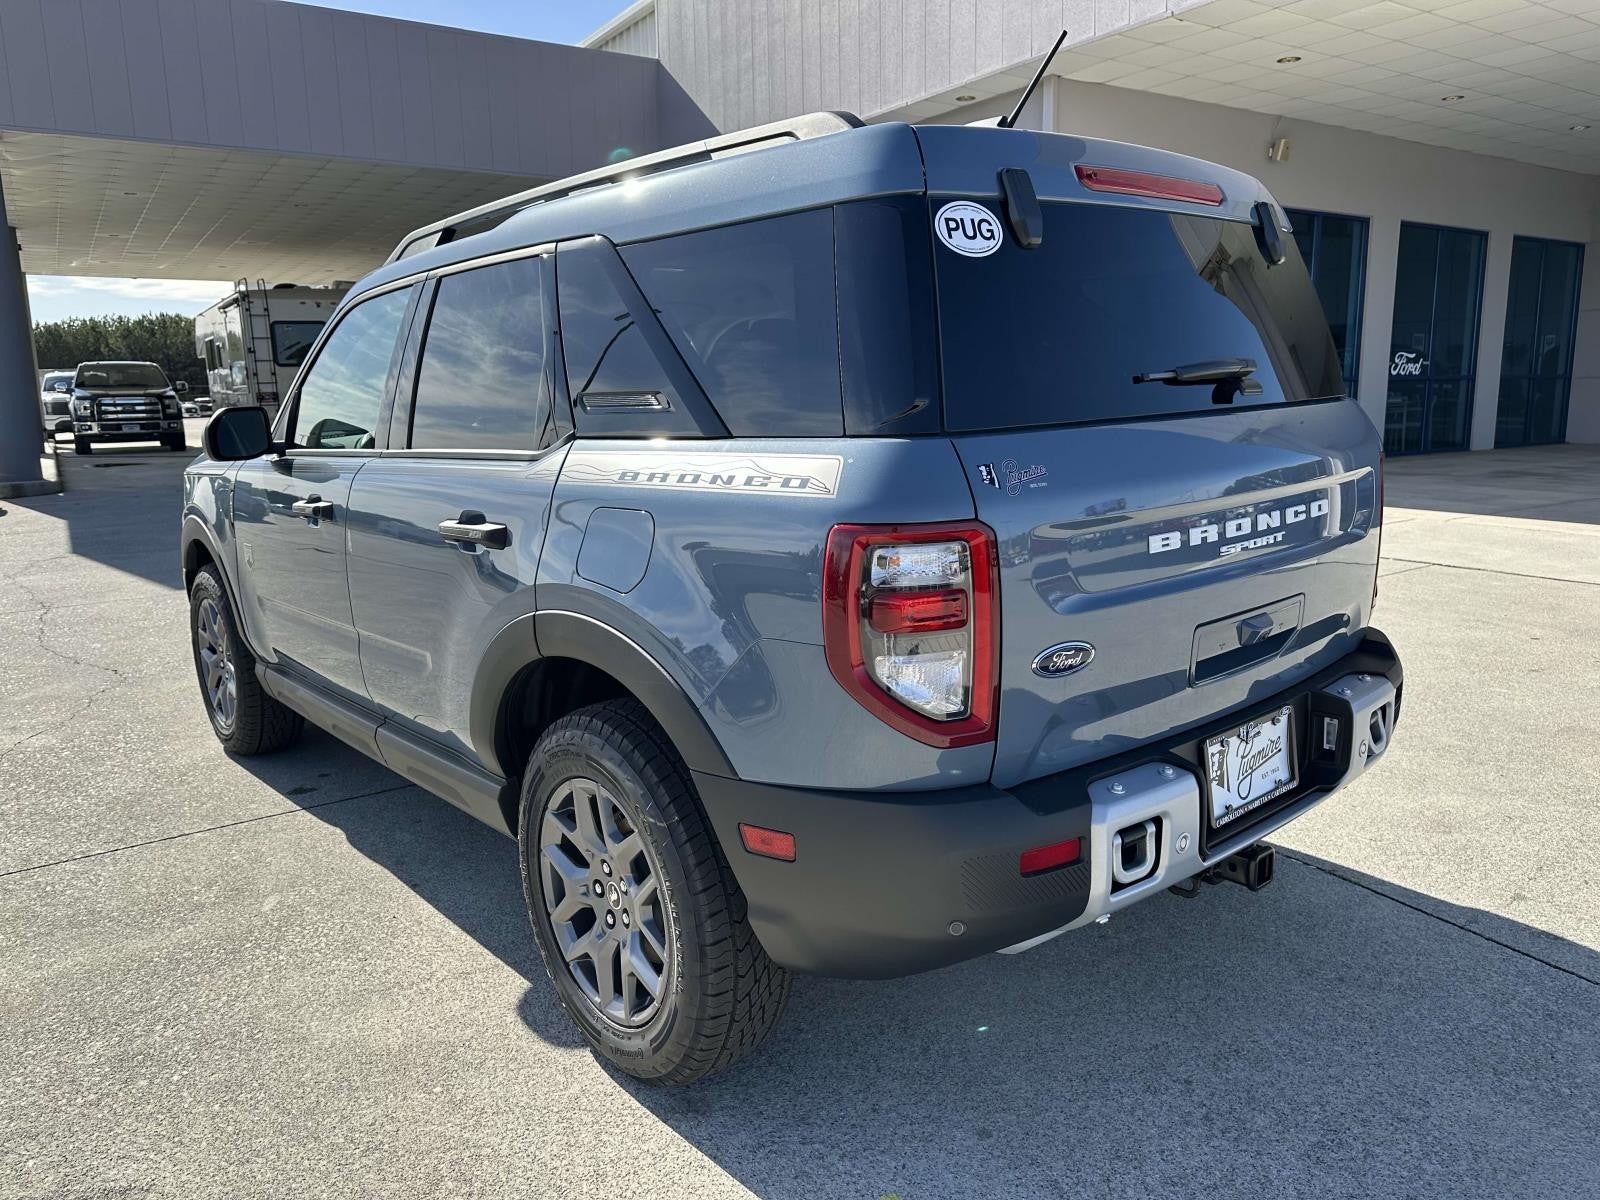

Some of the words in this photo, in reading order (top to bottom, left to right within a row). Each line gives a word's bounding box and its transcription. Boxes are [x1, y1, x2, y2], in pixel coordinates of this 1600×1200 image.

[944, 217, 996, 241] PUG
[1391, 351, 1424, 376] Ford
[617, 471, 811, 490] BRONCO
[1148, 499, 1329, 554] BRONCO
[1219, 531, 1286, 556] SPORT
[1049, 650, 1083, 671] Ford
[1236, 735, 1283, 801] Pugmire
